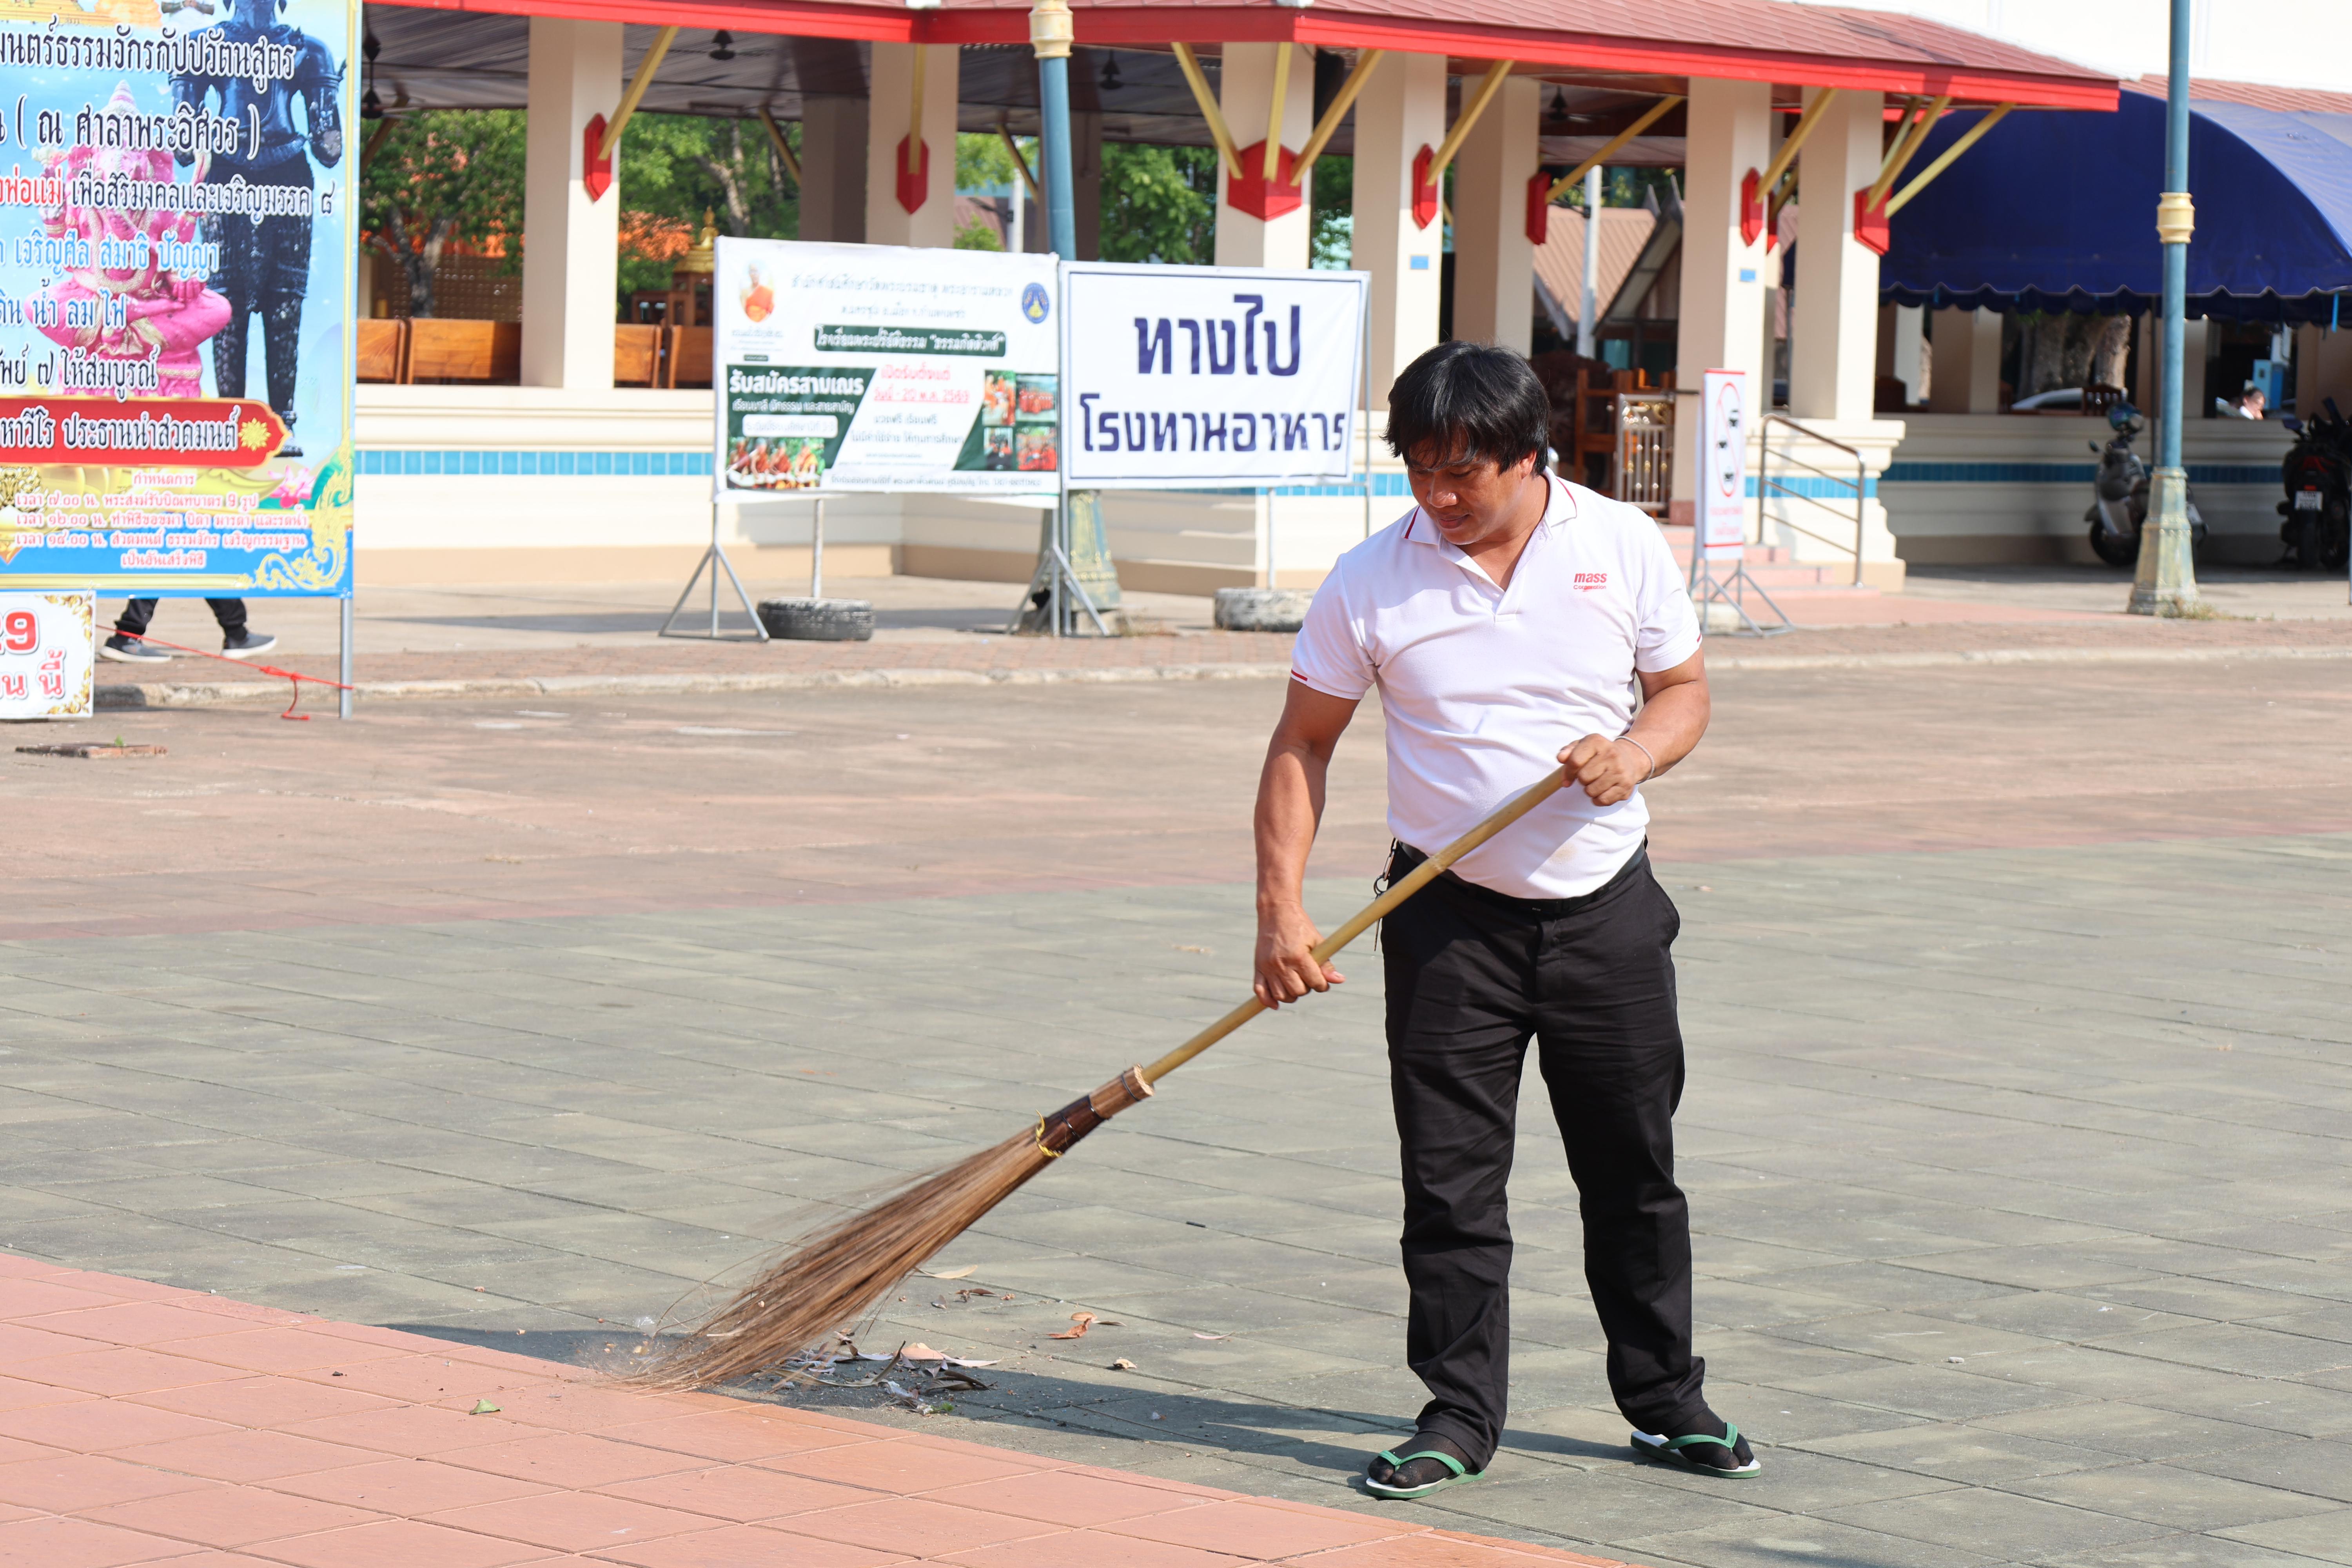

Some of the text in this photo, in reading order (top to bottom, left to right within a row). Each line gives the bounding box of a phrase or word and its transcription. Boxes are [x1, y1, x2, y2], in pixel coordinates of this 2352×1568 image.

[76, 103, 239, 153] ศาลาพระอิศวร
[16, 229, 89, 274] เจริญศีล
[101, 234, 148, 267] สมาธิ
[157, 231, 219, 279] ปัญญา
[32, 278, 56, 325] น้ำ
[67, 301, 93, 325] ลม
[99, 289, 125, 327] ไฟ
[1134, 294, 1301, 376] ทางไป
[60, 345, 160, 399] ให้สมบูรณ์
[729, 368, 864, 396] รับสมัครสามเณร
[64, 407, 238, 448] ประธานนำสวดมนต์
[1080, 393, 1345, 452] โรงทานอาหาร
[134, 472, 194, 485] กำหนดการ
[17, 495, 43, 506] เวลา
[240, 495, 258, 511] รูป
[17, 514, 43, 525] เวลา
[112, 512, 181, 526] ทำพิธีขอขมา
[187, 512, 211, 526] บิดา
[215, 515, 250, 526] มารดา
[256, 506, 307, 526] และรดน้ำ
[17, 533, 43, 544] เวลา
[112, 529, 162, 545] สวดมนต์
[167, 532, 218, 545] ธรรมจักร
[224, 533, 305, 550] เจริญกรรมฐาน
[122, 550, 205, 566] เป็นอันเสร็จพิธี
[1574, 573, 1607, 583] mass
[38, 648, 63, 695] นี้
